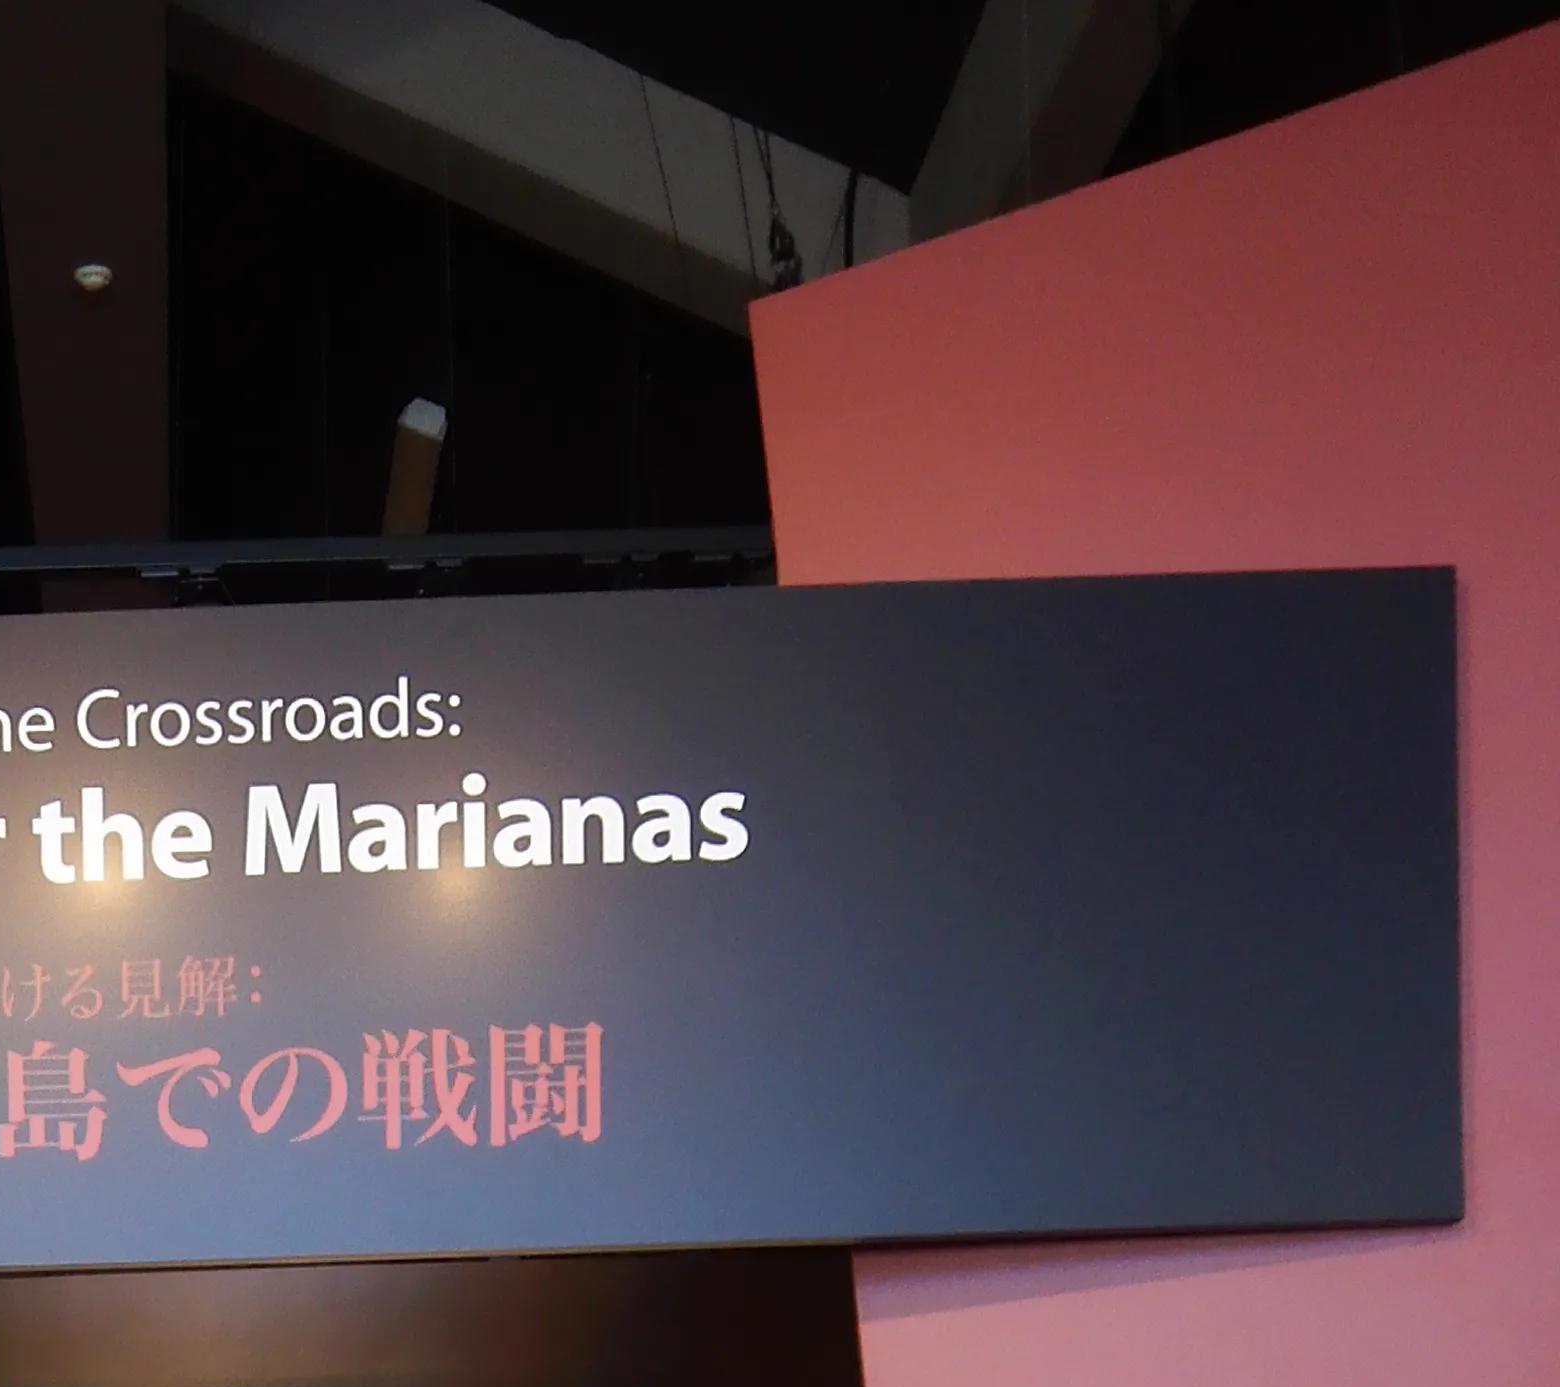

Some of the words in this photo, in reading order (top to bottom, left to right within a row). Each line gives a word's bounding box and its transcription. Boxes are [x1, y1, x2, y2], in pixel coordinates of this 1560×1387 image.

[77, 677, 461, 749] Crossroads:
[32, 789, 212, 883] the
[244, 771, 751, 876] Marianas
